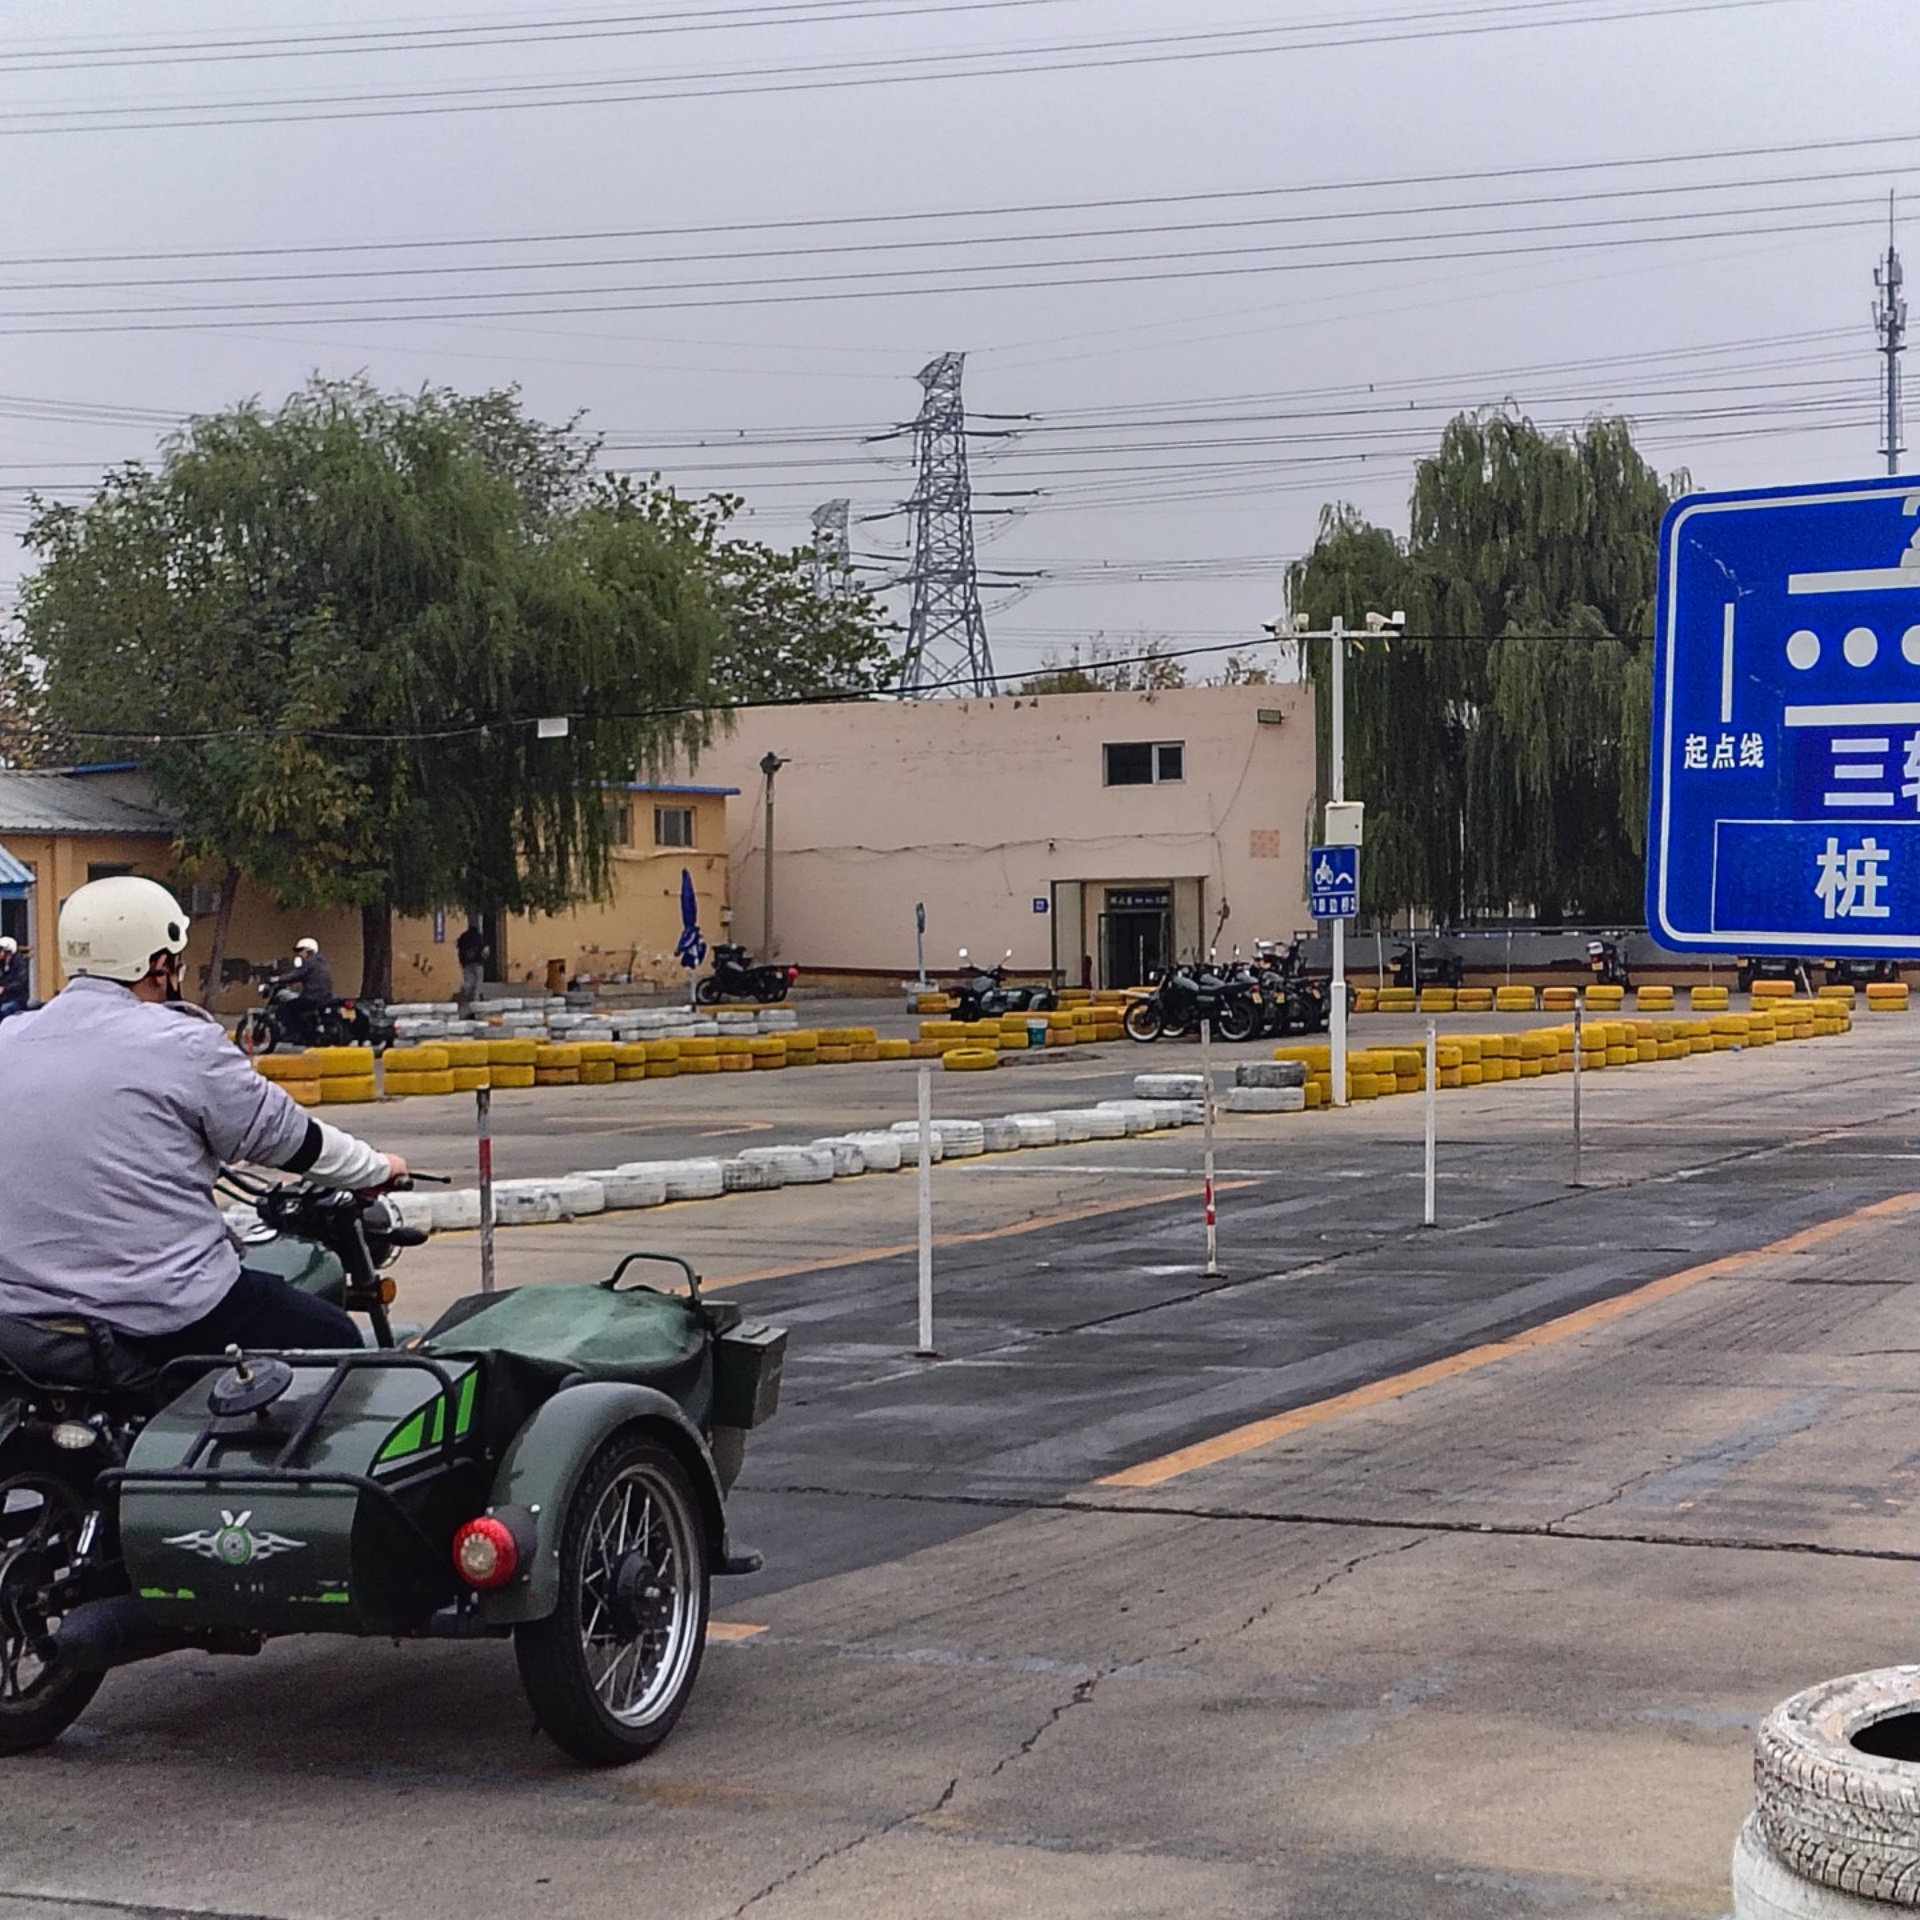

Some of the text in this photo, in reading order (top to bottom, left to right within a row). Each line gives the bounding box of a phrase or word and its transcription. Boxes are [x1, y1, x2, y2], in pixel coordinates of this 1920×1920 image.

[1683, 732, 1765, 770] 起点线
[1824, 730, 1920, 813] 三
[1815, 837, 1891, 919] 桩
